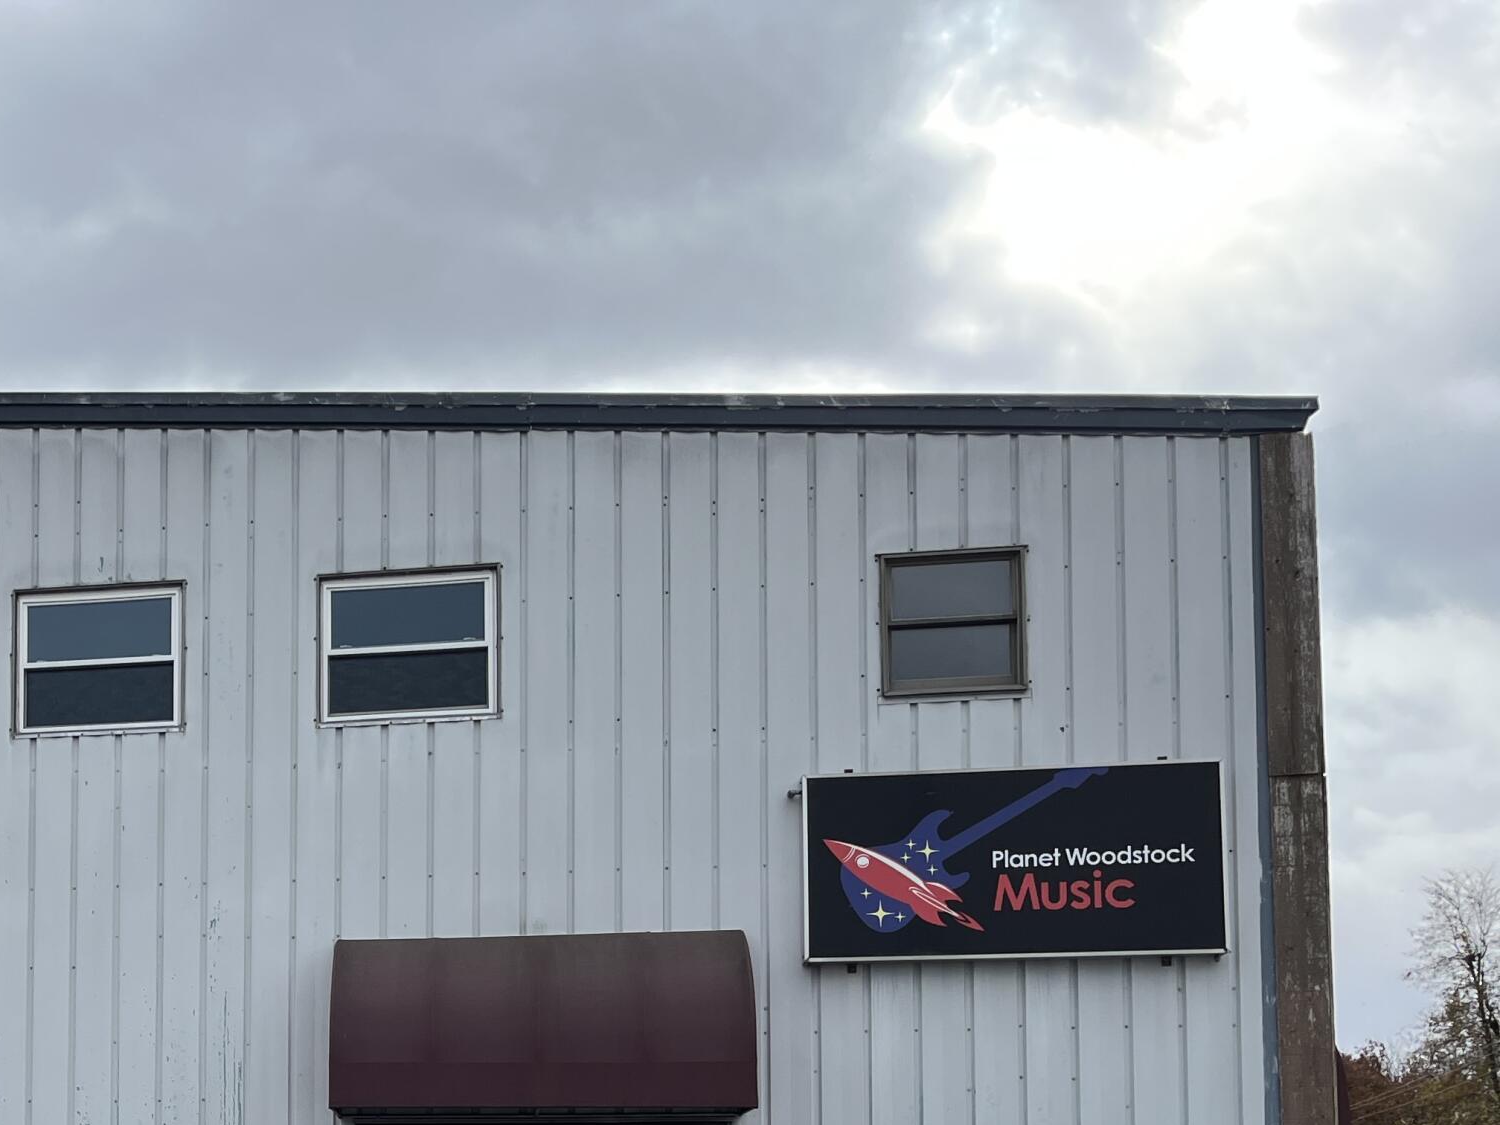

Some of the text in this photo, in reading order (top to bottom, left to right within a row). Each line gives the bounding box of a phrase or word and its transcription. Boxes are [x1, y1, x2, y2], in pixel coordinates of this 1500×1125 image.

[992, 843, 1196, 868] Planet Woodstock
[993, 869, 1136, 911] Music
